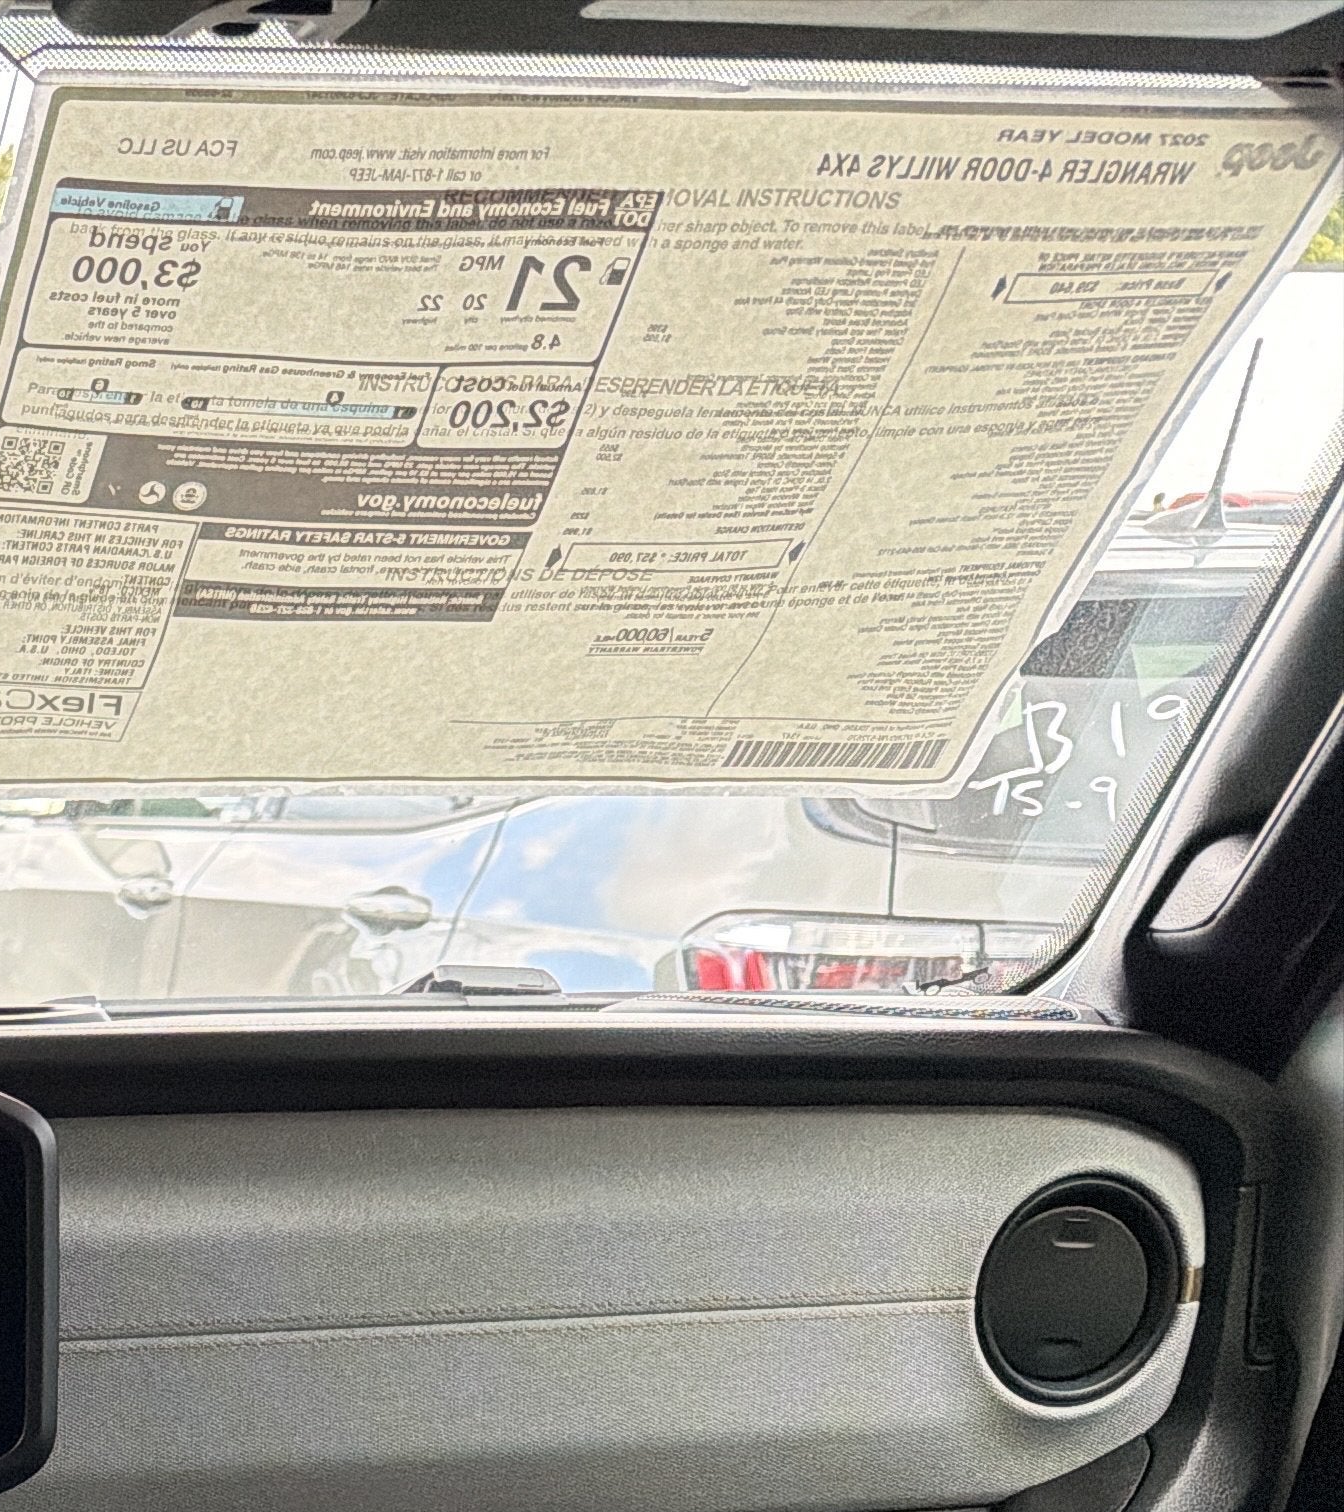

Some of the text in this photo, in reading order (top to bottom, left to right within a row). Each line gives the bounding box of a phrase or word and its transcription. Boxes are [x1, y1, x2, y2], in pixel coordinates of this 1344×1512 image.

[737, 189, 901, 210] INSTRUCTIONS
[686, 222, 726, 235] sharp
[783, 221, 801, 233] To
[804, 222, 858, 233] remove
[862, 222, 889, 235] this
[674, 239, 729, 251] sponge
[732, 238, 761, 249] and
